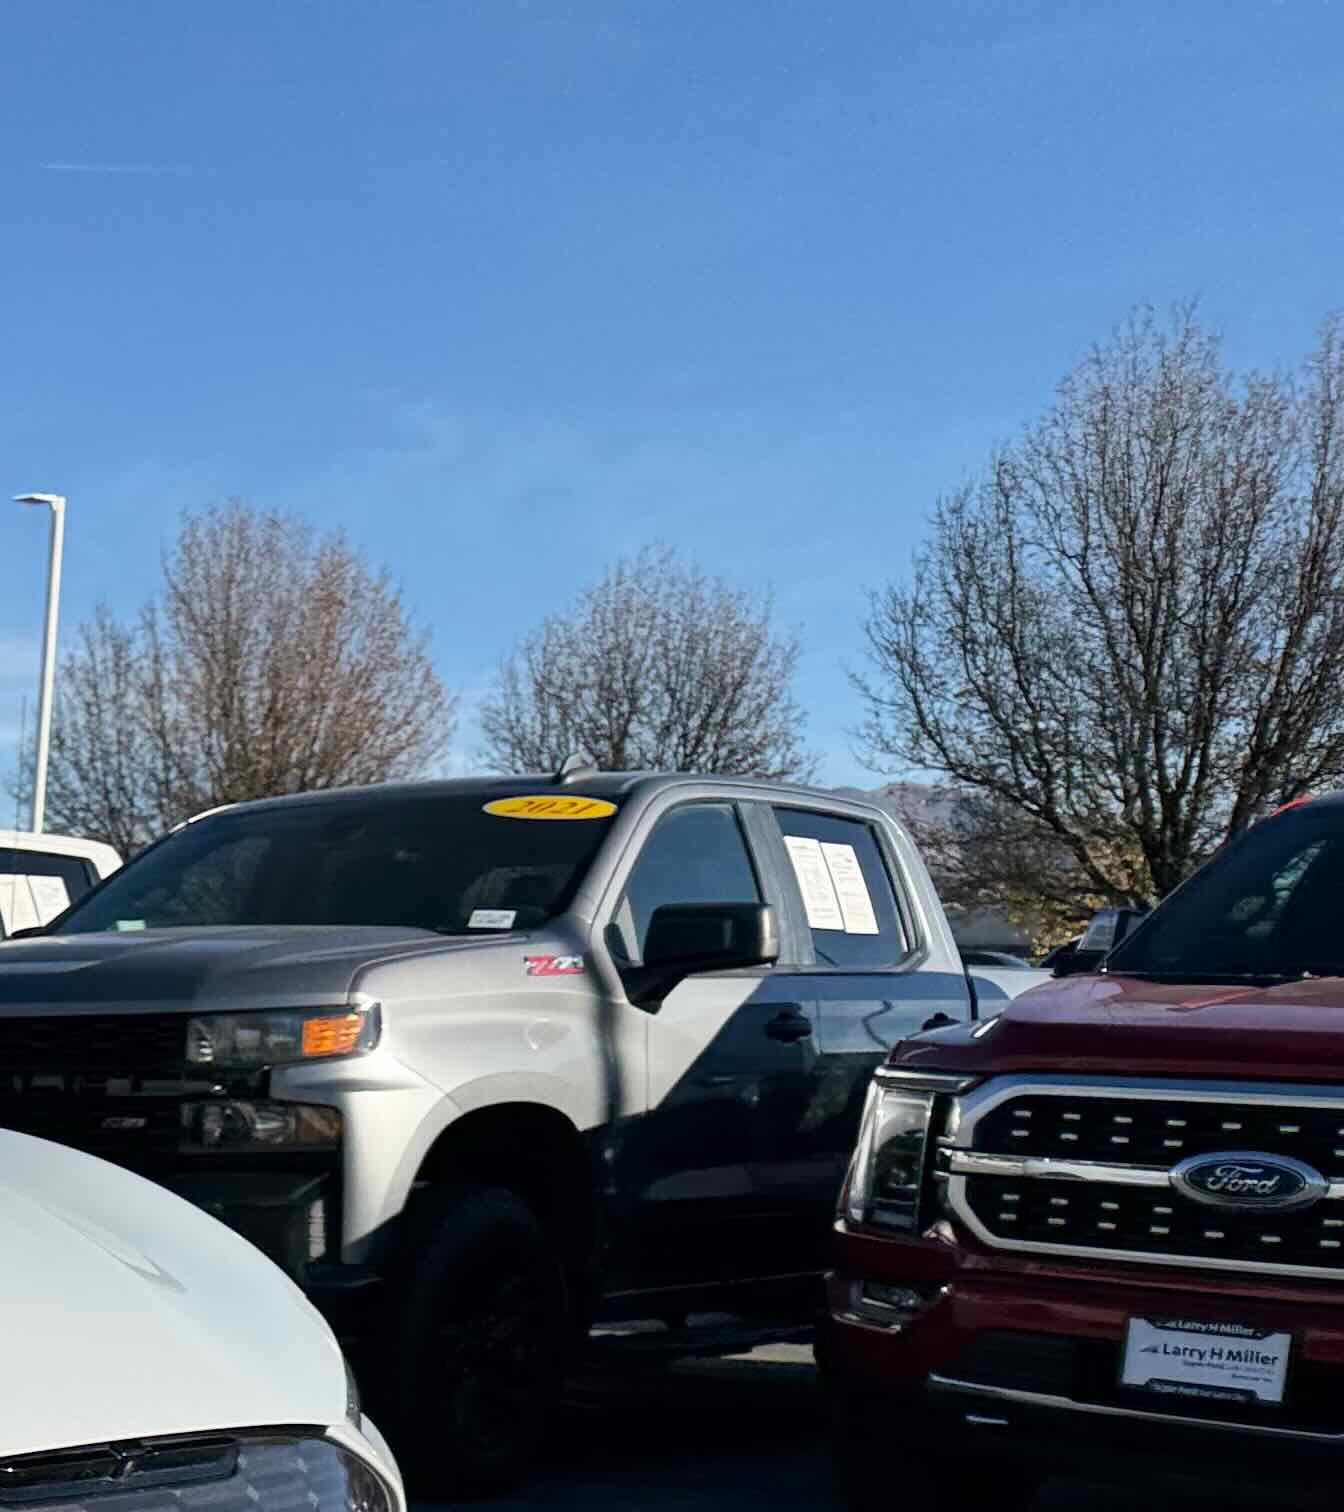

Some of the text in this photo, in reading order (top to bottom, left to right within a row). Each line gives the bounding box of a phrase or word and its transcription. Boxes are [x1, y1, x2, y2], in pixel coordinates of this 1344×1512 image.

[1207, 1165, 1280, 1194] Ford
[1163, 1343, 1279, 1366] Larry H Miller
